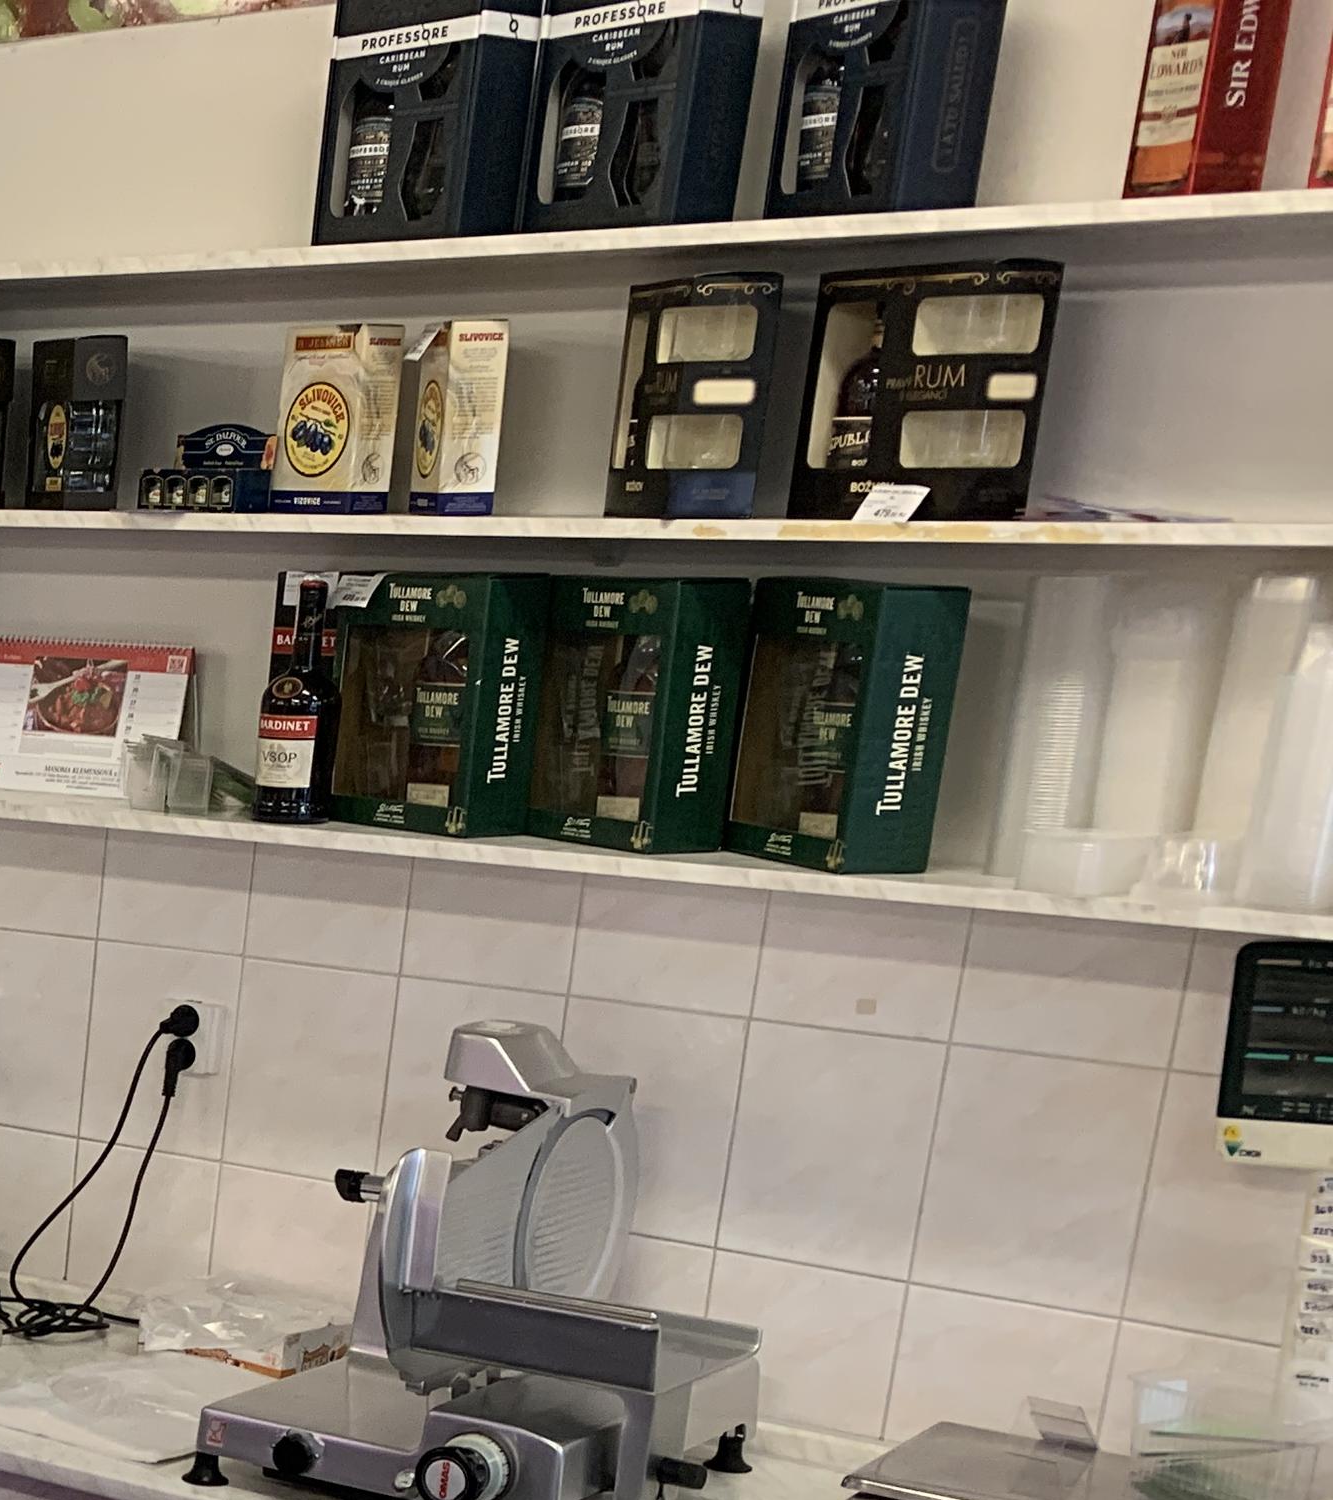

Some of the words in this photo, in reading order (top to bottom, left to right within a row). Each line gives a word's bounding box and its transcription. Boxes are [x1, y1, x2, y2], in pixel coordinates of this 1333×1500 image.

[574, 1, 666, 28] PROFESSORE
[360, 25, 449, 52] PROFESSORE
[605, 39, 624, 52] RUM
[391, 61, 410, 74] RUM
[1225, 58, 1251, 108] SIR
[459, 332, 504, 342] SLIVOVICE
[913, 364, 966, 390] RUM
[298, 388, 346, 424] SLIVOVICE
[389, 583, 432, 600] TULLAMORE
[583, 588, 624, 605] TULLAMORE
[797, 591, 834, 611] TULLAMORE
[400, 601, 418, 612] DEW
[594, 605, 611, 618] DEW
[804, 610, 821, 624] DEW
[416, 687, 459, 705] TULLAMORE
[607, 696, 650, 715] TULLAMORE
[709, 685, 721, 727] WHISKEY
[425, 704, 443, 718] DEW
[487, 682, 514, 783] TULLAMORE
[502, 637, 520, 678] DEW
[512, 718, 521, 742] IRISH
[517, 675, 526, 717] WHISKEY
[915, 697, 932, 743] WHISKEY
[616, 714, 634, 728] DEW
[676, 691, 707, 797] TULLAMORE
[693, 644, 714, 687] DEW
[705, 729, 714, 755] IRISH
[876, 702, 916, 815] TULLAMORE
[905, 653, 924, 698] DEW
[262, 751, 297, 764] VSOP
[912, 745, 922, 771] IRISH
[439, 1462, 450, 1499] OMAS
